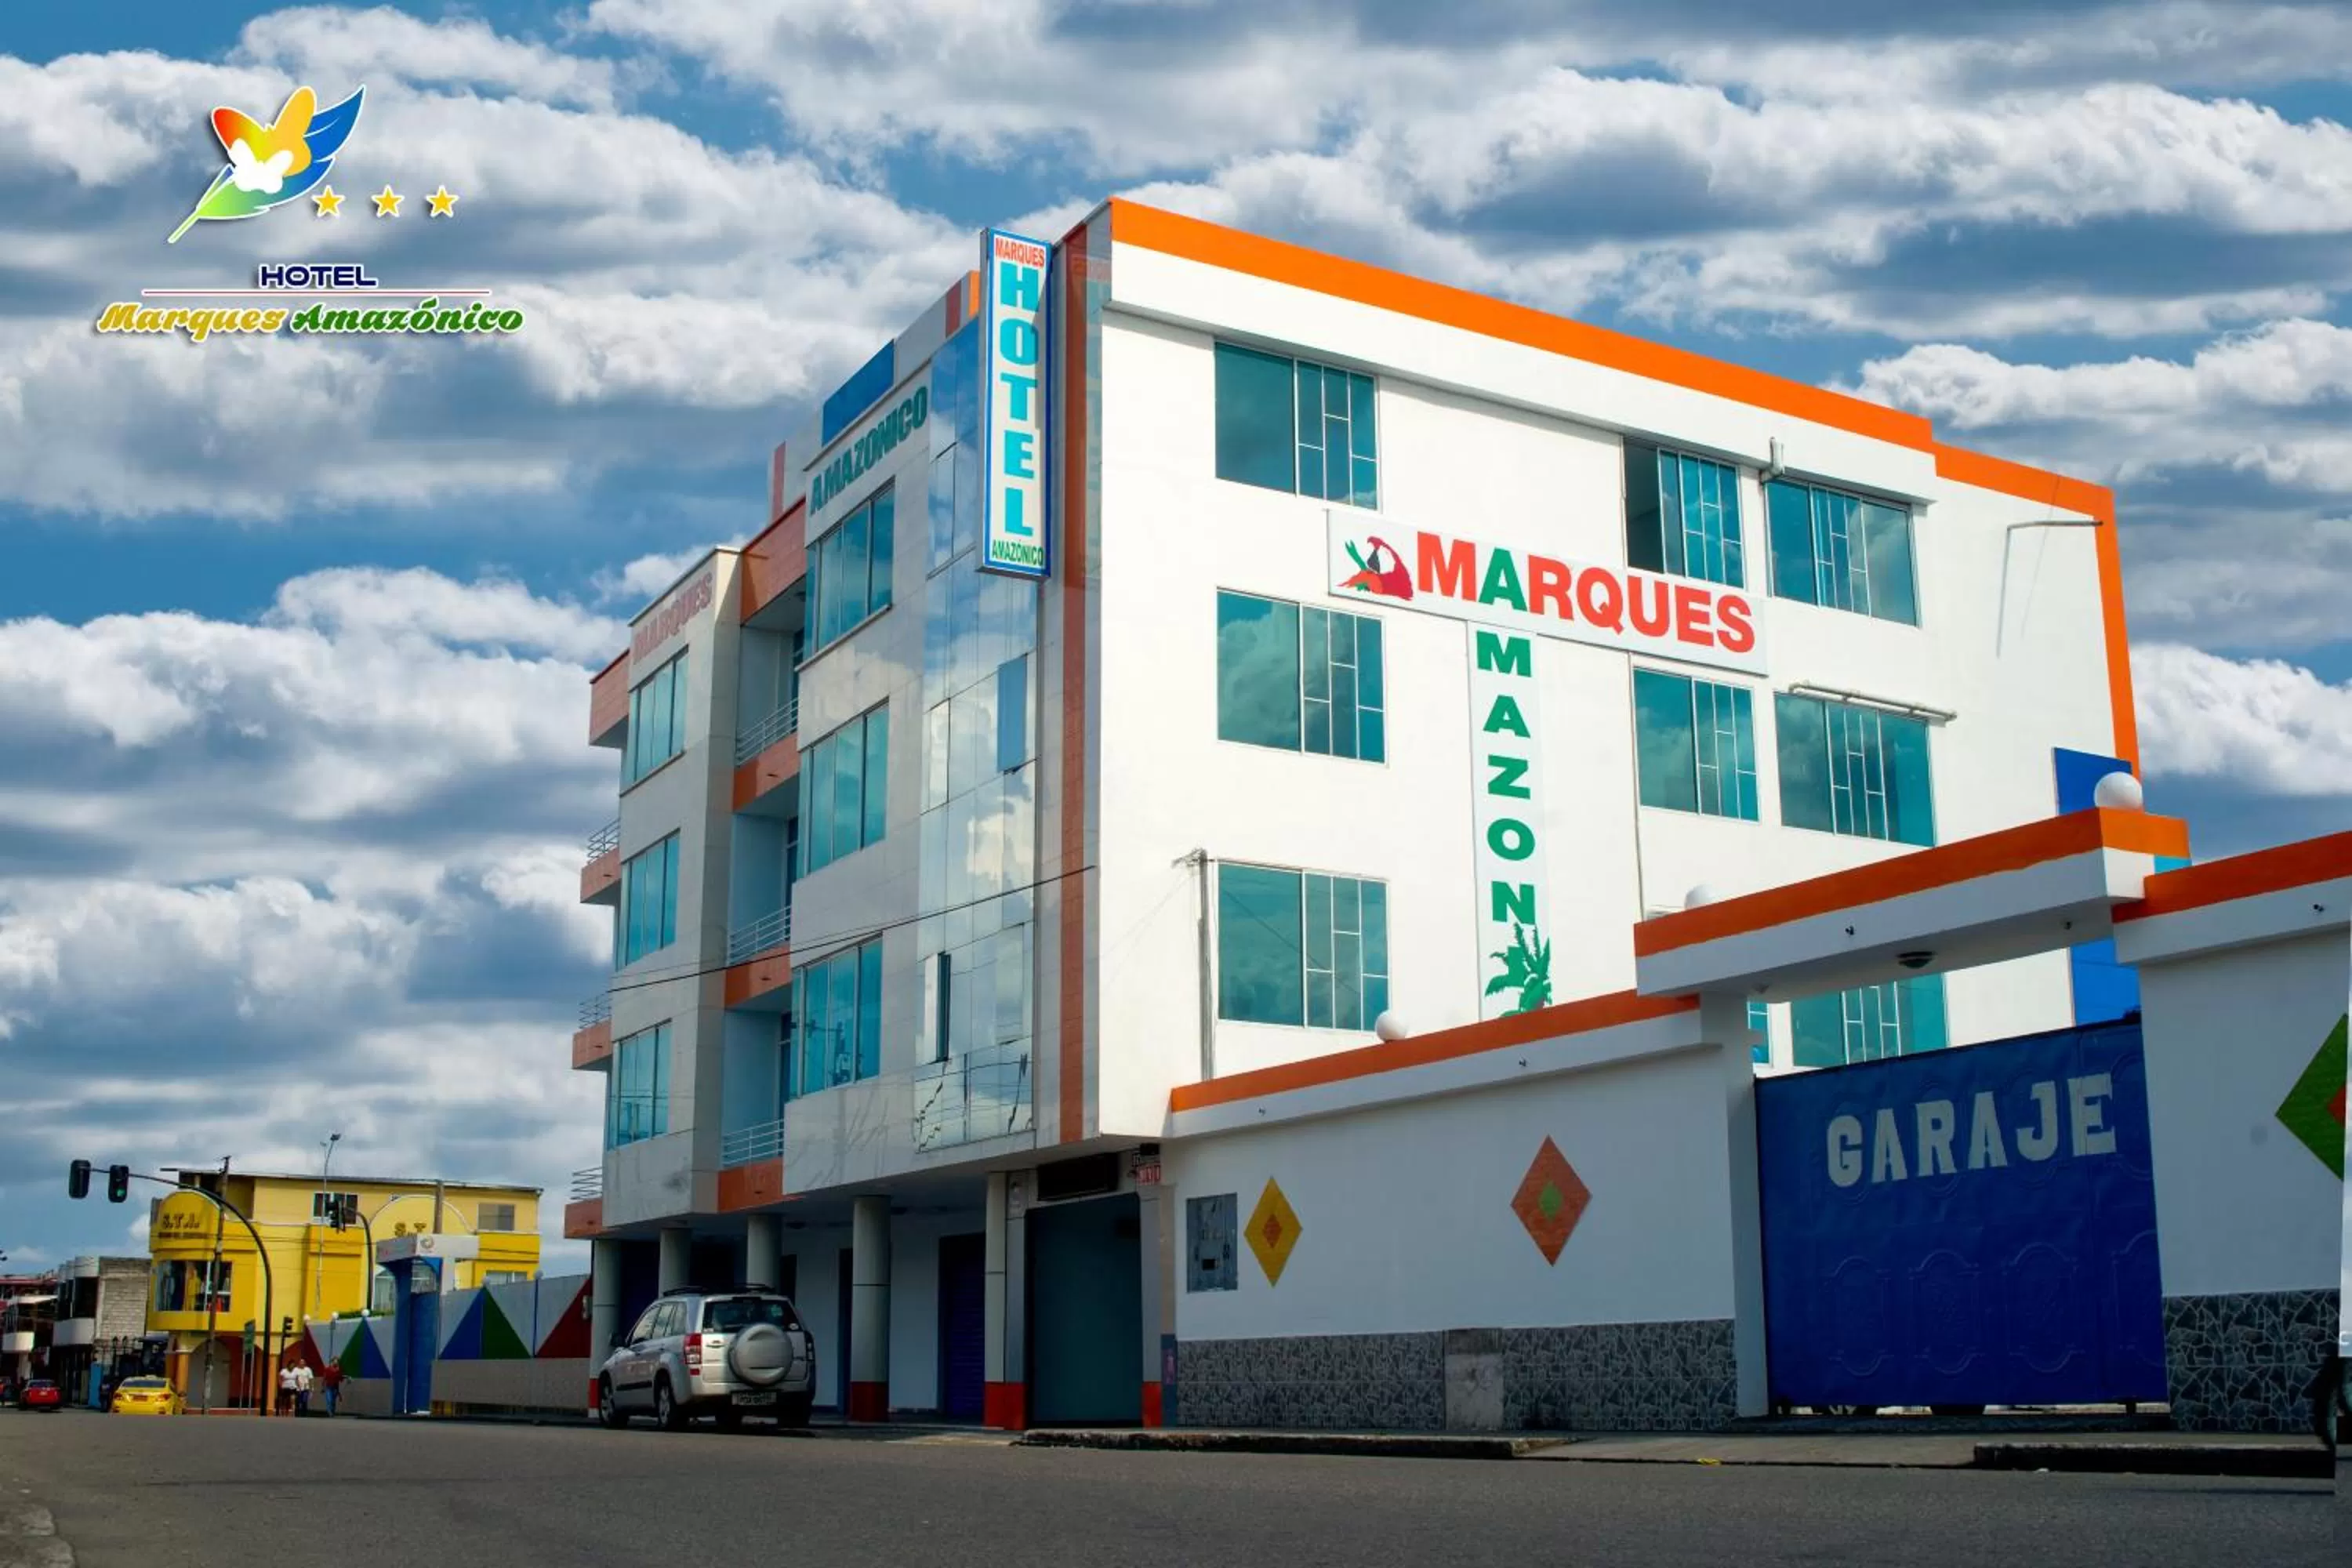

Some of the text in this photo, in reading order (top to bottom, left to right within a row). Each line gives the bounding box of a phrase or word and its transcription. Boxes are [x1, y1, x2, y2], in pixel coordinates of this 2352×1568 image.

[995, 238, 1044, 267] MARQUES
[810, 386, 928, 517] AMAZONICO
[1000, 262, 1039, 537] HOTEL
[633, 572, 712, 665] MARQUES
[1417, 531, 1755, 653] MARQUES
[1827, 1073, 2117, 1188] GARAJE
